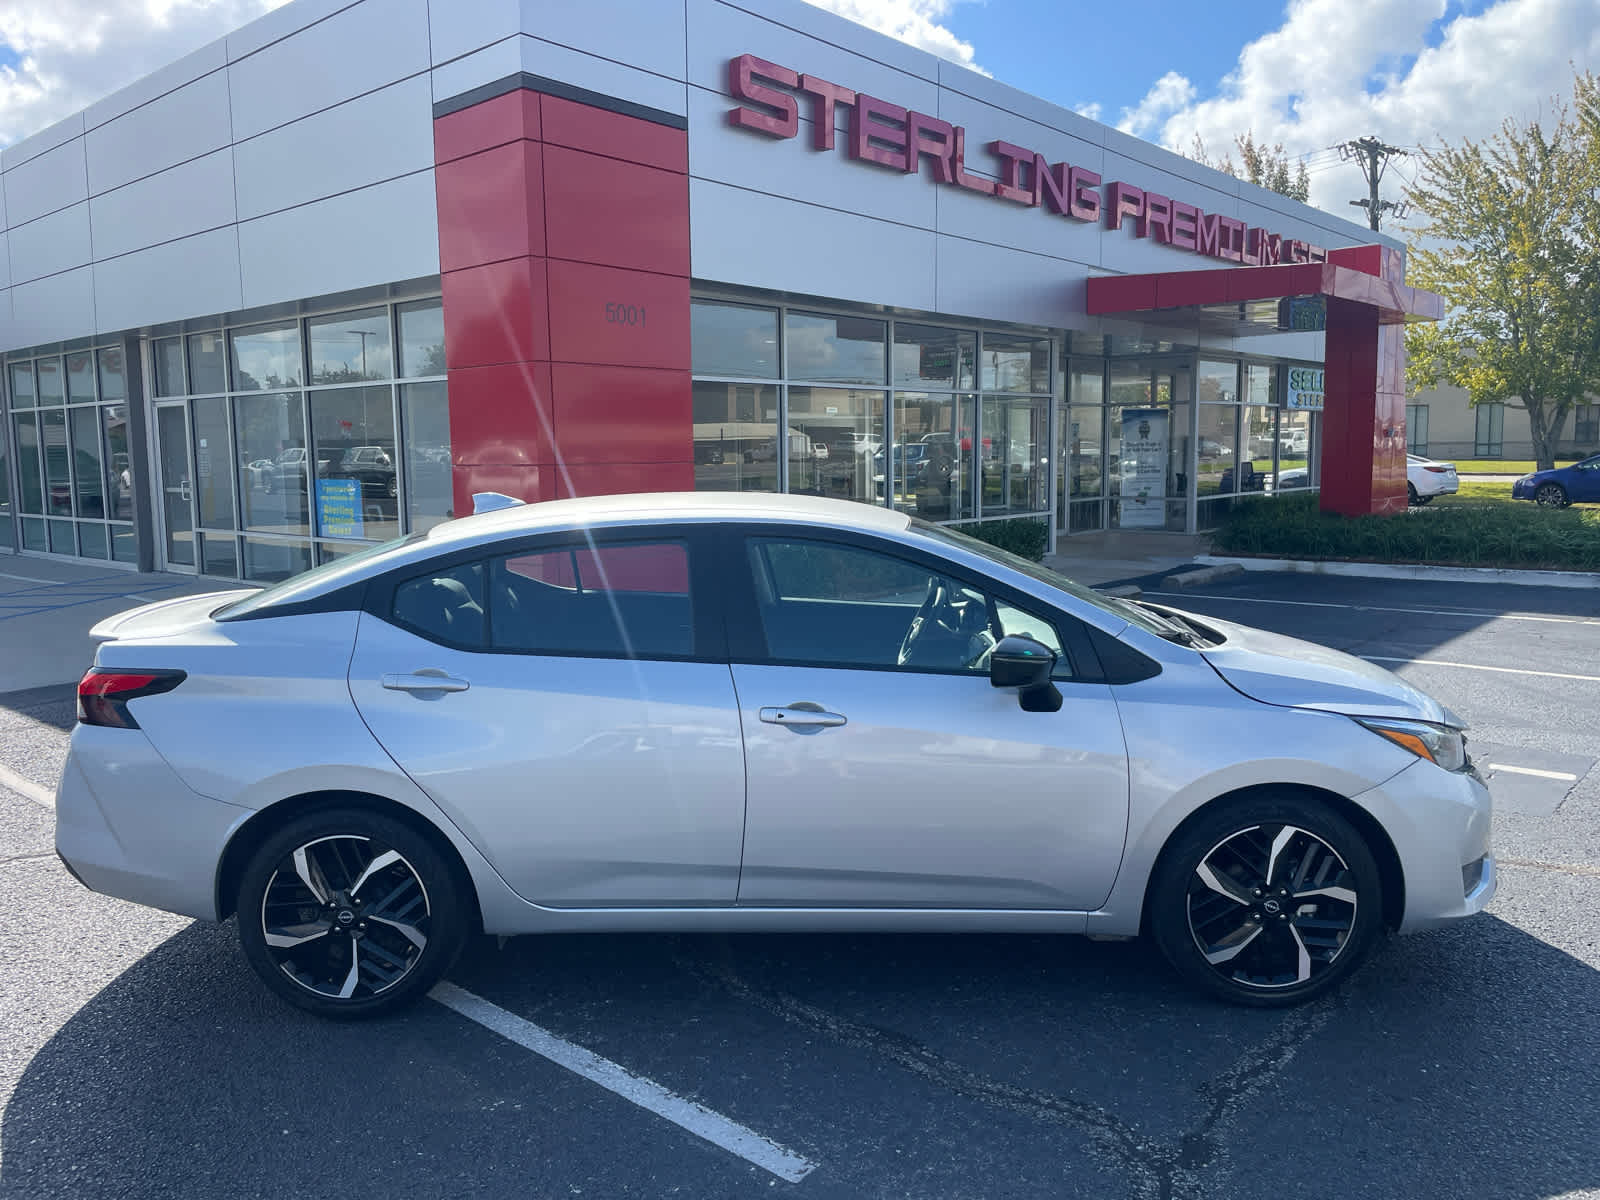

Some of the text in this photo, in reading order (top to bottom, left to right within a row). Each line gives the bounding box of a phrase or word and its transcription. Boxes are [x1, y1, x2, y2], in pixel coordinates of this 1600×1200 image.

[728, 53, 1102, 223] STERLING
[1107, 181, 1282, 266] PREMIUM
[605, 301, 646, 328] 5001
